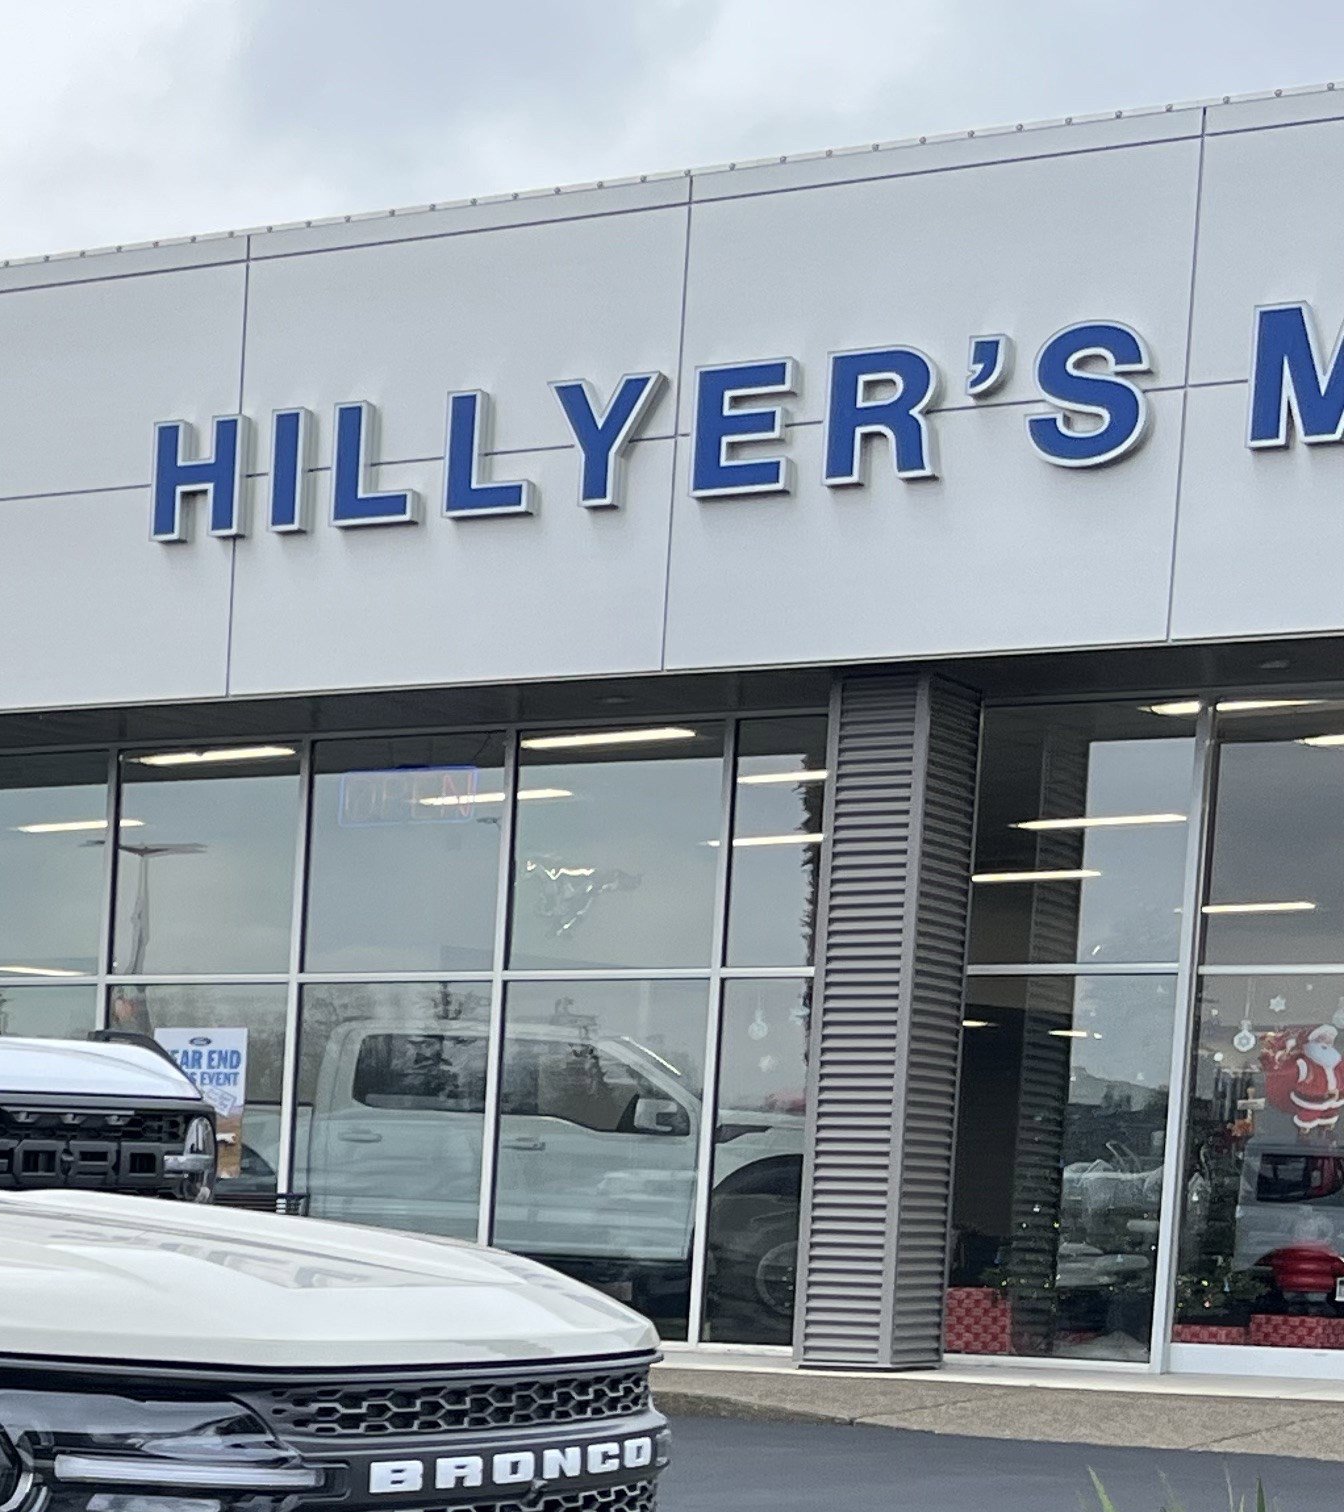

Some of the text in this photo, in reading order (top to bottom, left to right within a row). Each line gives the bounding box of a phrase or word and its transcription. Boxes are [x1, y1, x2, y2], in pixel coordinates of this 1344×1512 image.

[148, 318, 1152, 544] HILLYER'S
[200, 1071, 240, 1087] EVENT
[207, 1049, 241, 1070] END
[369, 1436, 653, 1495] BRONCO
